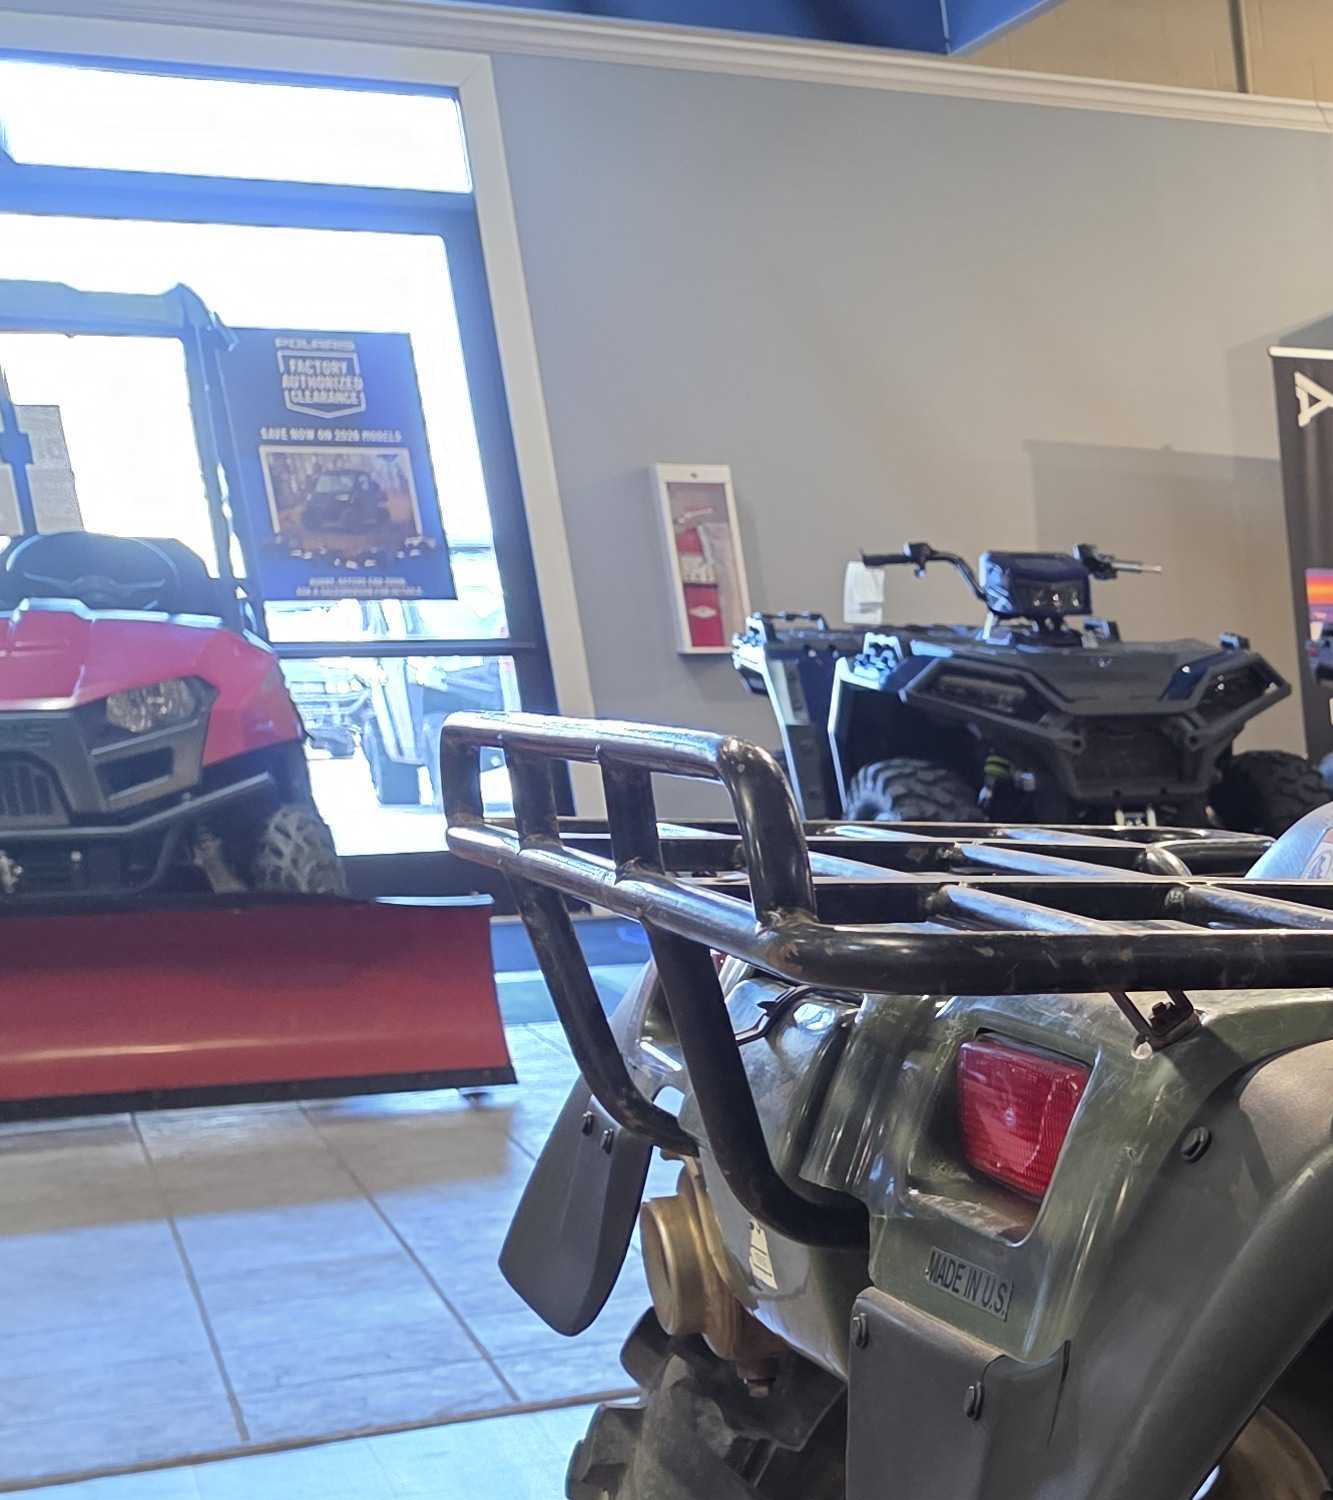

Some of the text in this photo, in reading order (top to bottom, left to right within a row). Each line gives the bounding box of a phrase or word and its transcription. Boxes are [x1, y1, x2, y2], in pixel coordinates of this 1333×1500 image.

[275, 337, 355, 350] POLARIS
[288, 359, 347, 376] FACTORY
[282, 373, 363, 391] AUTHORIZED
[290, 388, 360, 405] CLEARANCE
[259, 426, 289, 441] SAVE
[290, 428, 315, 441] NOW
[929, 1250, 966, 1294] MADE
[963, 1267, 984, 1302] IN
